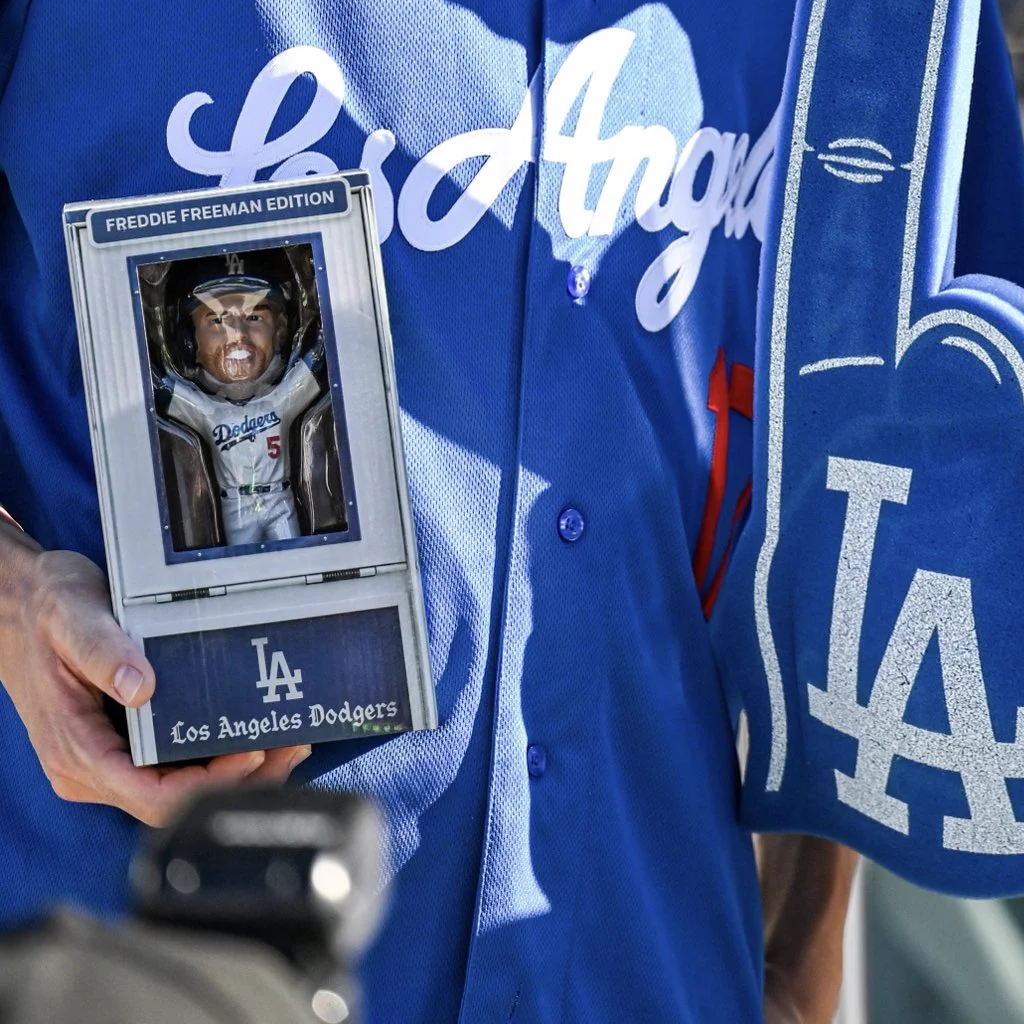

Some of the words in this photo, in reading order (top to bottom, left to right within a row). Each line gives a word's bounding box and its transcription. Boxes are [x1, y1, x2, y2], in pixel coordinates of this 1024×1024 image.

[105, 210, 177, 232] FREDDIE
[180, 200, 263, 222] FREEMAN
[267, 189, 336, 211] EDITION
[212, 409, 282, 450] Dodgers
[266, 435, 282, 459] 5
[251, 636, 304, 703] LA
[170, 720, 211, 744] Los
[217, 710, 303, 740] Angeles
[308, 701, 398, 727] Dodgers
